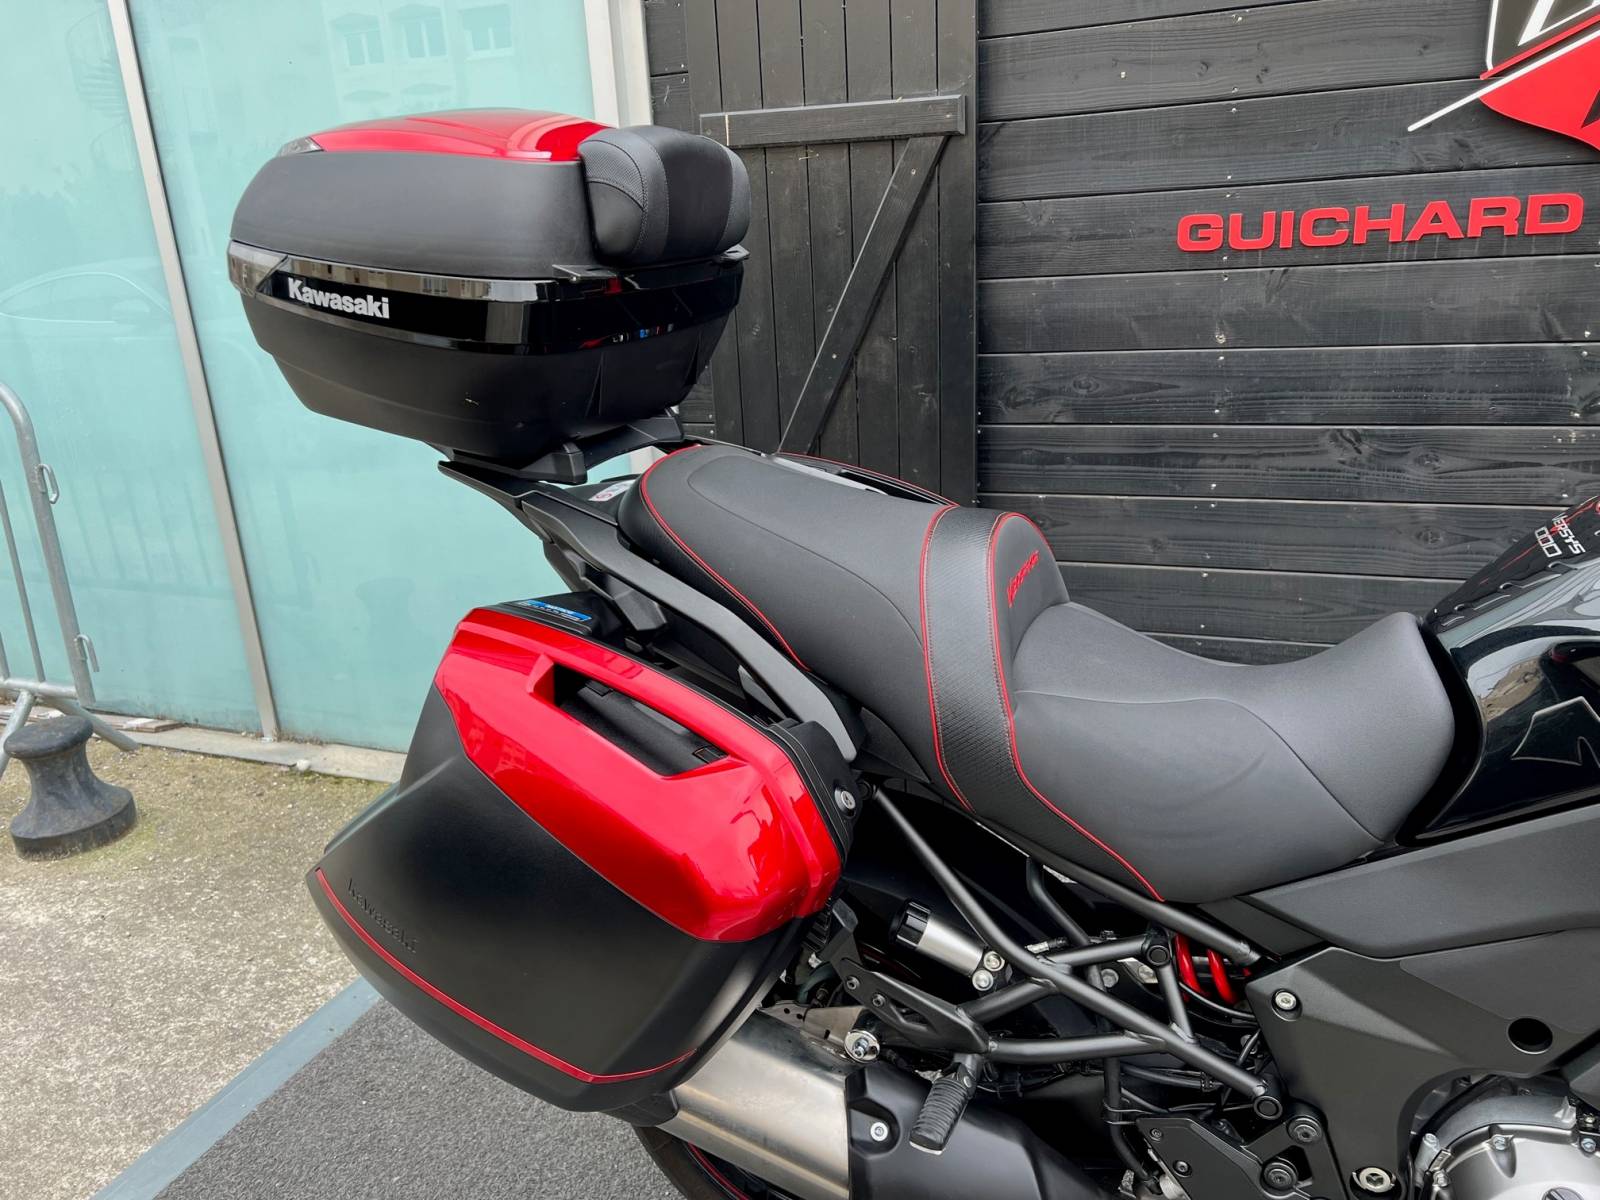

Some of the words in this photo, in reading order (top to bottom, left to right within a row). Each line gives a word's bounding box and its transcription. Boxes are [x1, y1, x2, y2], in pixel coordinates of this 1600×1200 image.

[1177, 193, 1584, 252] GUICHARD
[288, 277, 390, 319] Kawasaki
[1551, 512, 1586, 554] VERSYS
